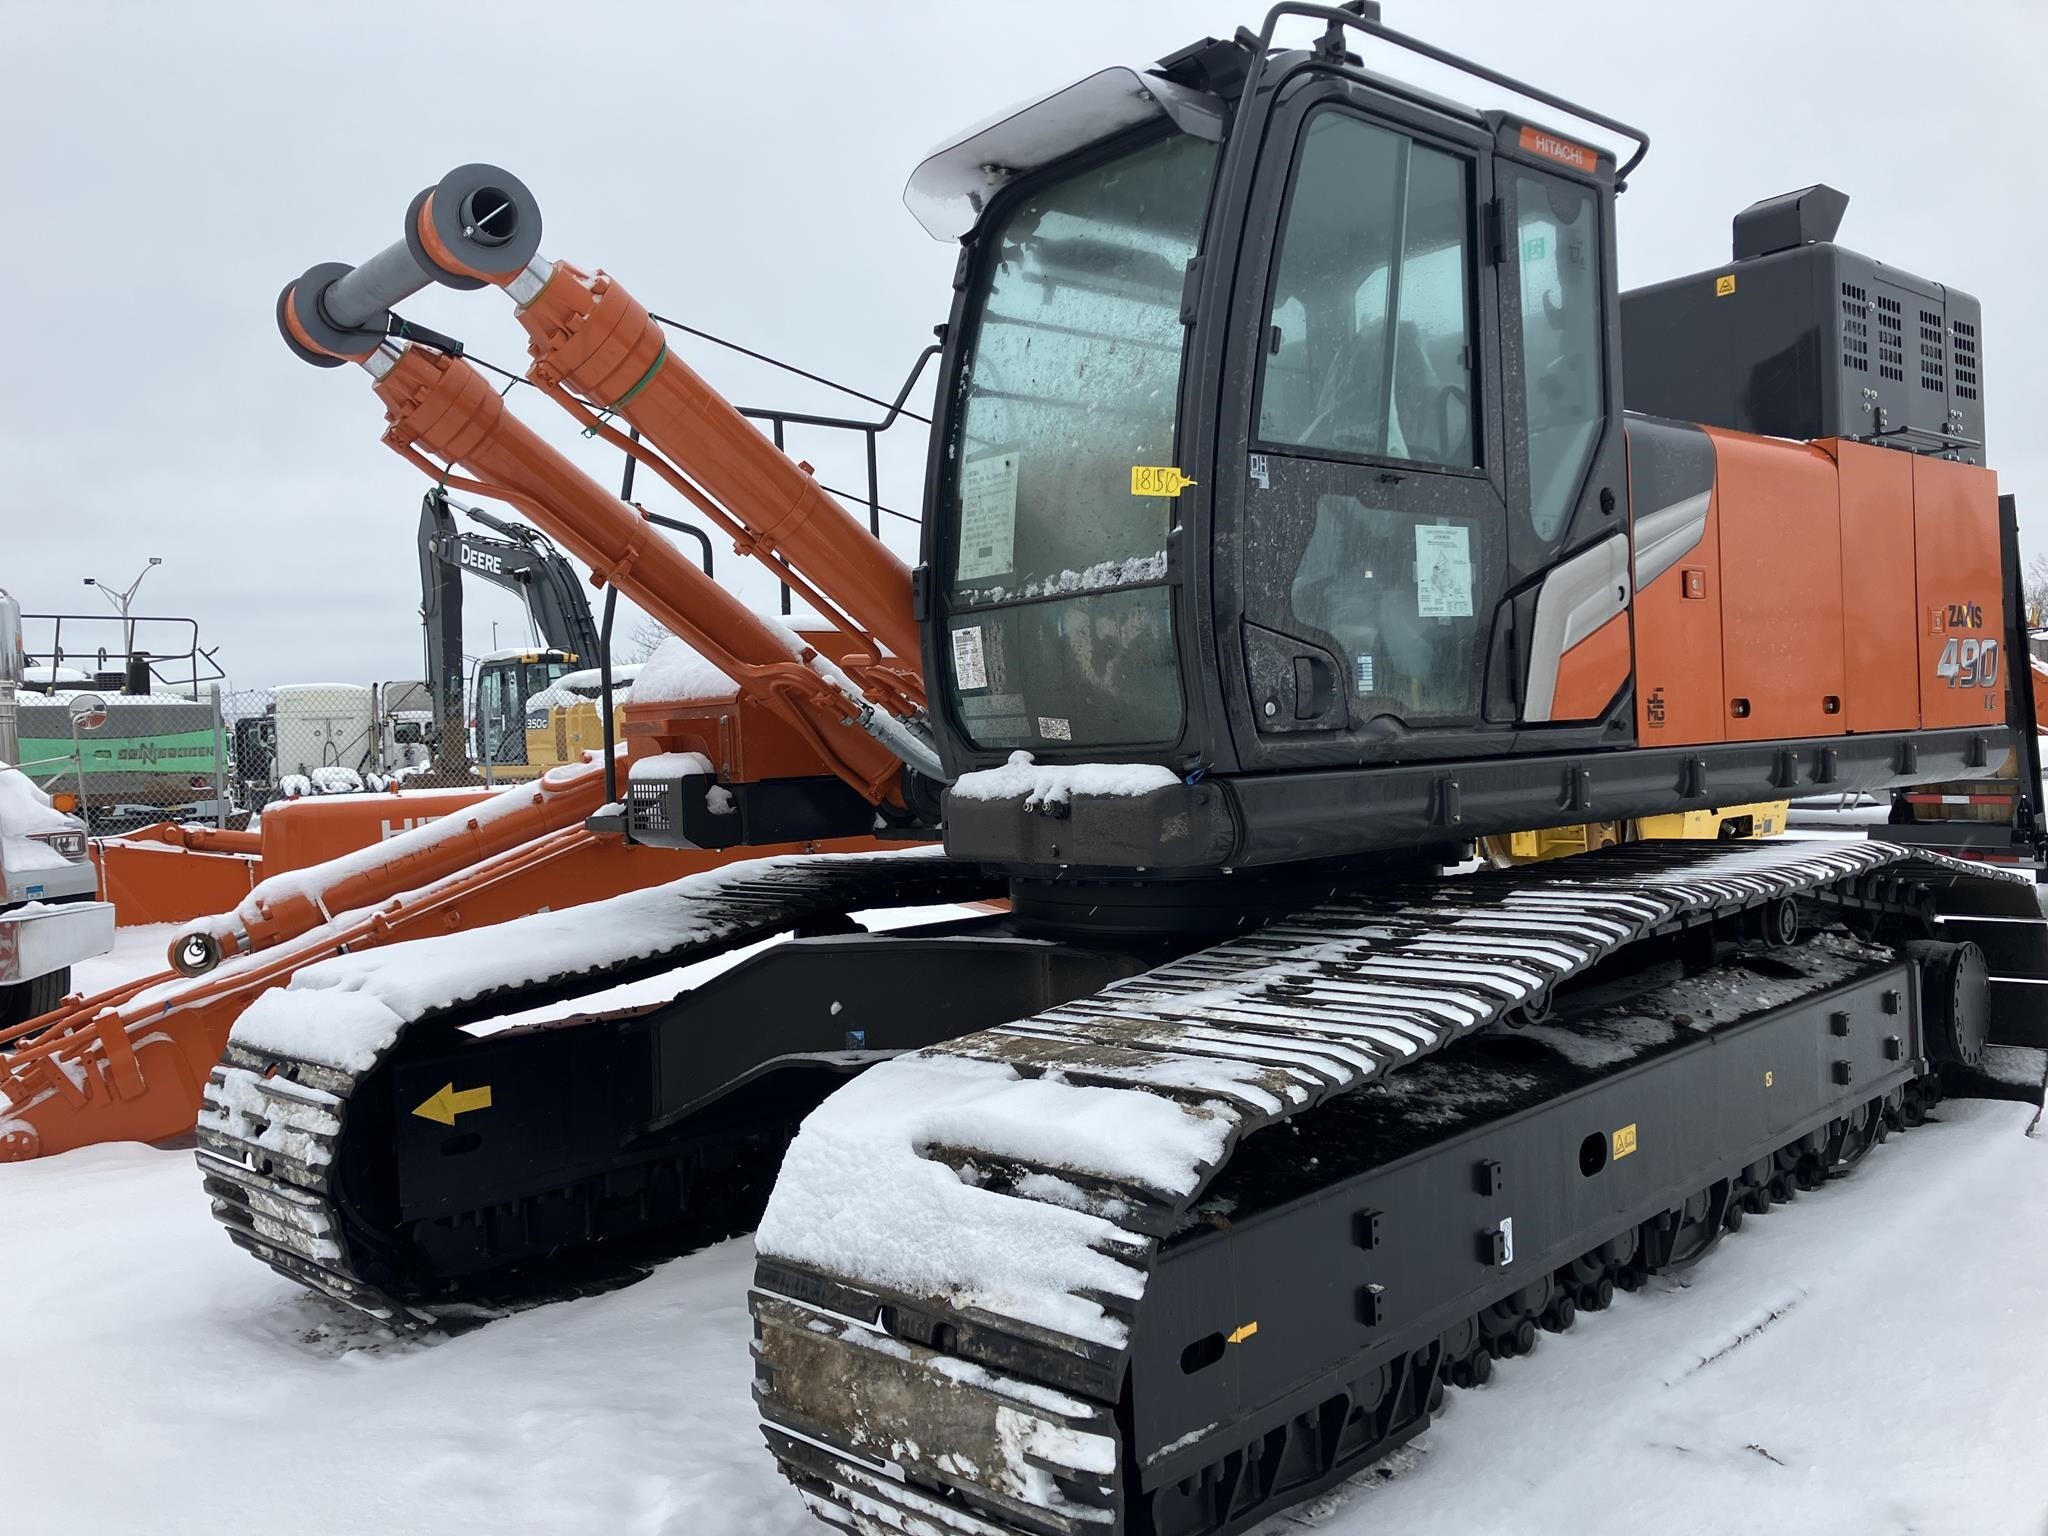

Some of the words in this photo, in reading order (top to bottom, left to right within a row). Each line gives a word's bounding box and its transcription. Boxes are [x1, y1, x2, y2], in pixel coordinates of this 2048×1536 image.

[1535, 135, 1583, 165] HITACHI
[461, 543, 502, 575] DEERE
[1948, 601, 1983, 628] ZAXIS
[1936, 637, 1999, 688] 490
[526, 718, 548, 729] 350G
